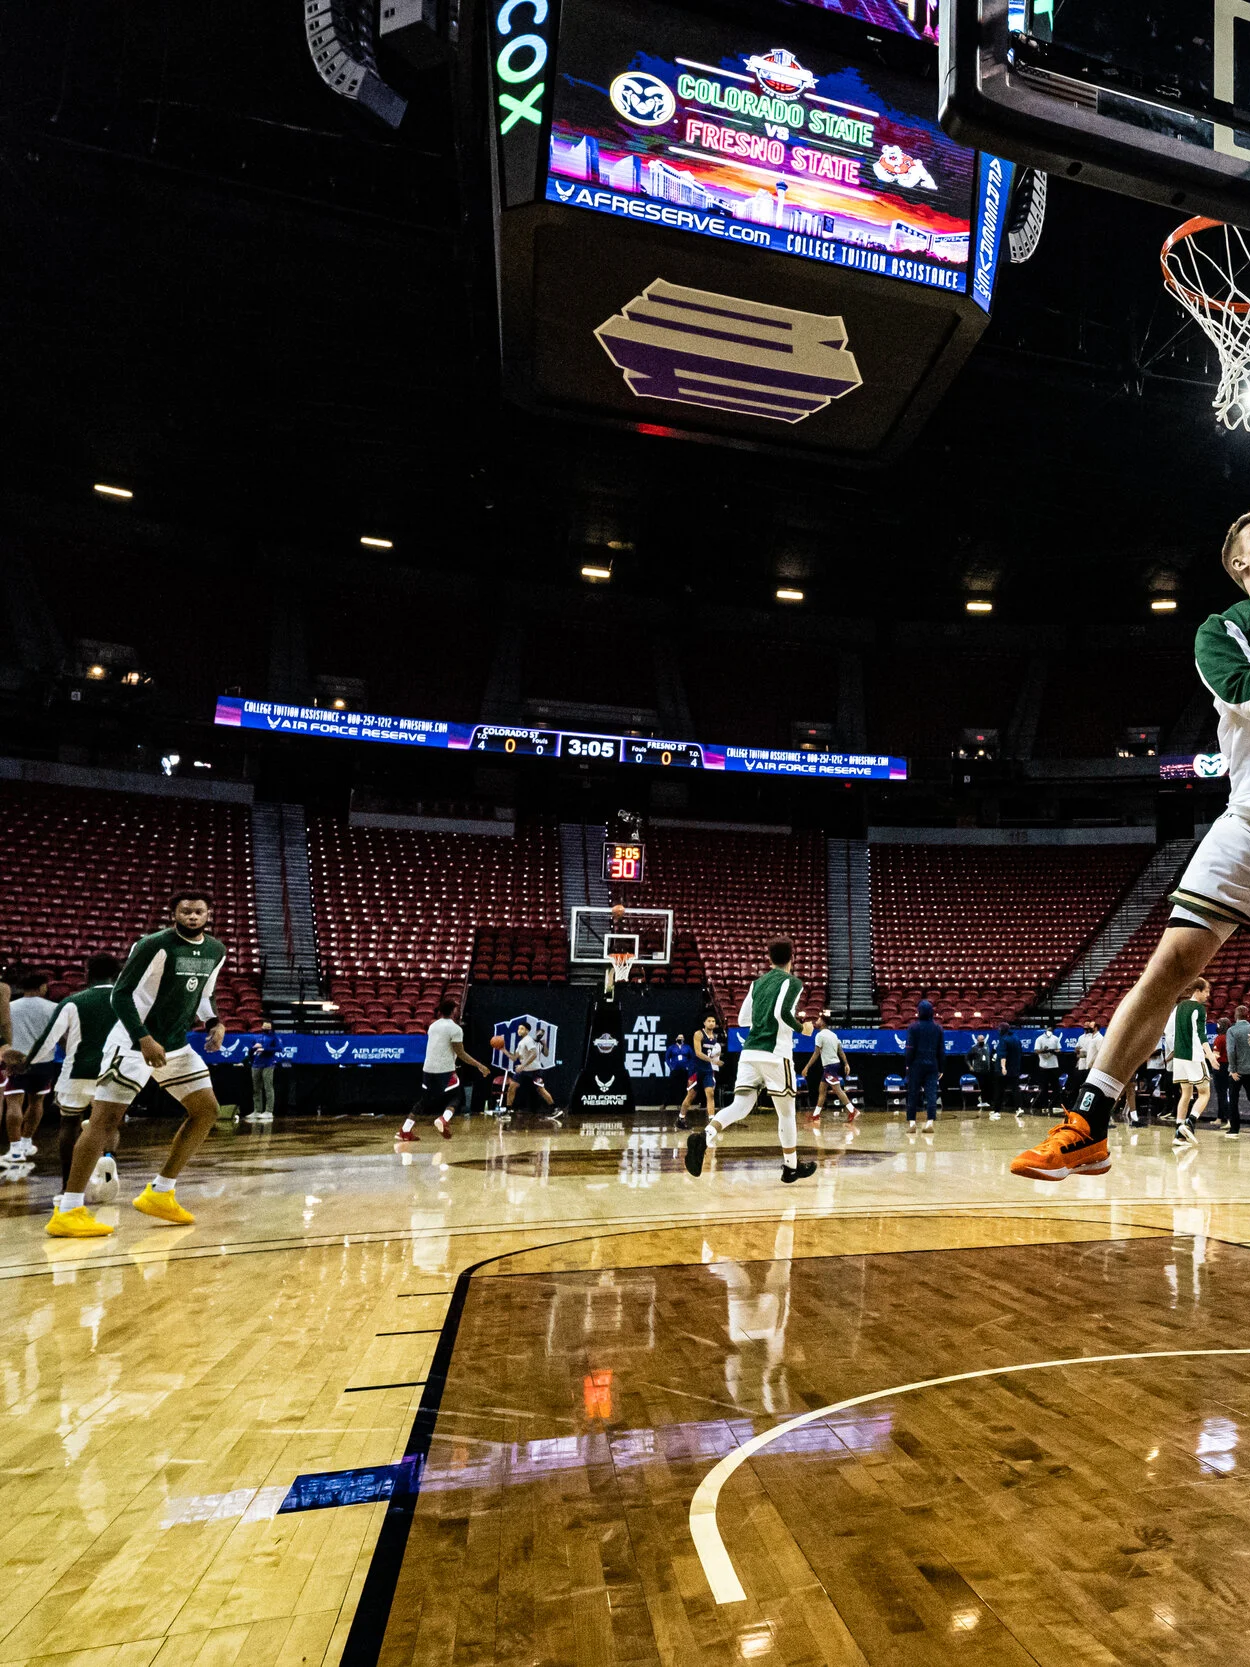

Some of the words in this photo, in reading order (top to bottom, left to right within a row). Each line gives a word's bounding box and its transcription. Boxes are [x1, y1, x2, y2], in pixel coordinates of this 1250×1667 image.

[497, 0, 549, 135] COX
[677, 74, 804, 129] COLORADO
[808, 109, 876, 148] STATE
[765, 123, 790, 142] VS
[685, 118, 786, 165] FRESNO
[790, 146, 862, 186] STATE
[575, 189, 772, 247] AFRESERVE.com
[786, 234, 836, 263] COLLEGE
[841, 245, 888, 273] TUITION
[890, 255, 960, 290] ASSISTANCE
[244, 701, 271, 715] COLLEGE
[273, 704, 299, 718] TUITION
[300, 708, 339, 723] ASSISTANCE
[281, 719, 307, 730] AIR
[310, 723, 358, 736] FORCE
[361, 728, 426, 743] RESERVE
[482, 727, 528, 738] COLORADO
[529, 731, 539, 739] ST
[478, 740, 485, 751] 4
[505, 738, 516, 753] 0
[536, 745, 544, 755] 0
[568, 738, 615, 758] 3:05
[647, 741, 676, 751] FRESNO
[677, 744, 687, 752] ST
[635, 753, 643, 763] 0
[661, 751, 672, 766] 0
[690, 757, 698, 768] 4
[755, 762, 777, 771] AIR
[778, 763, 817, 777] FORCE
[818, 765, 872, 776] RESERVE
[615, 847, 640, 860] 3:05
[611, 859, 635, 879] 30
[633, 1015, 661, 1033] AT
[624, 1034, 668, 1052] THE
